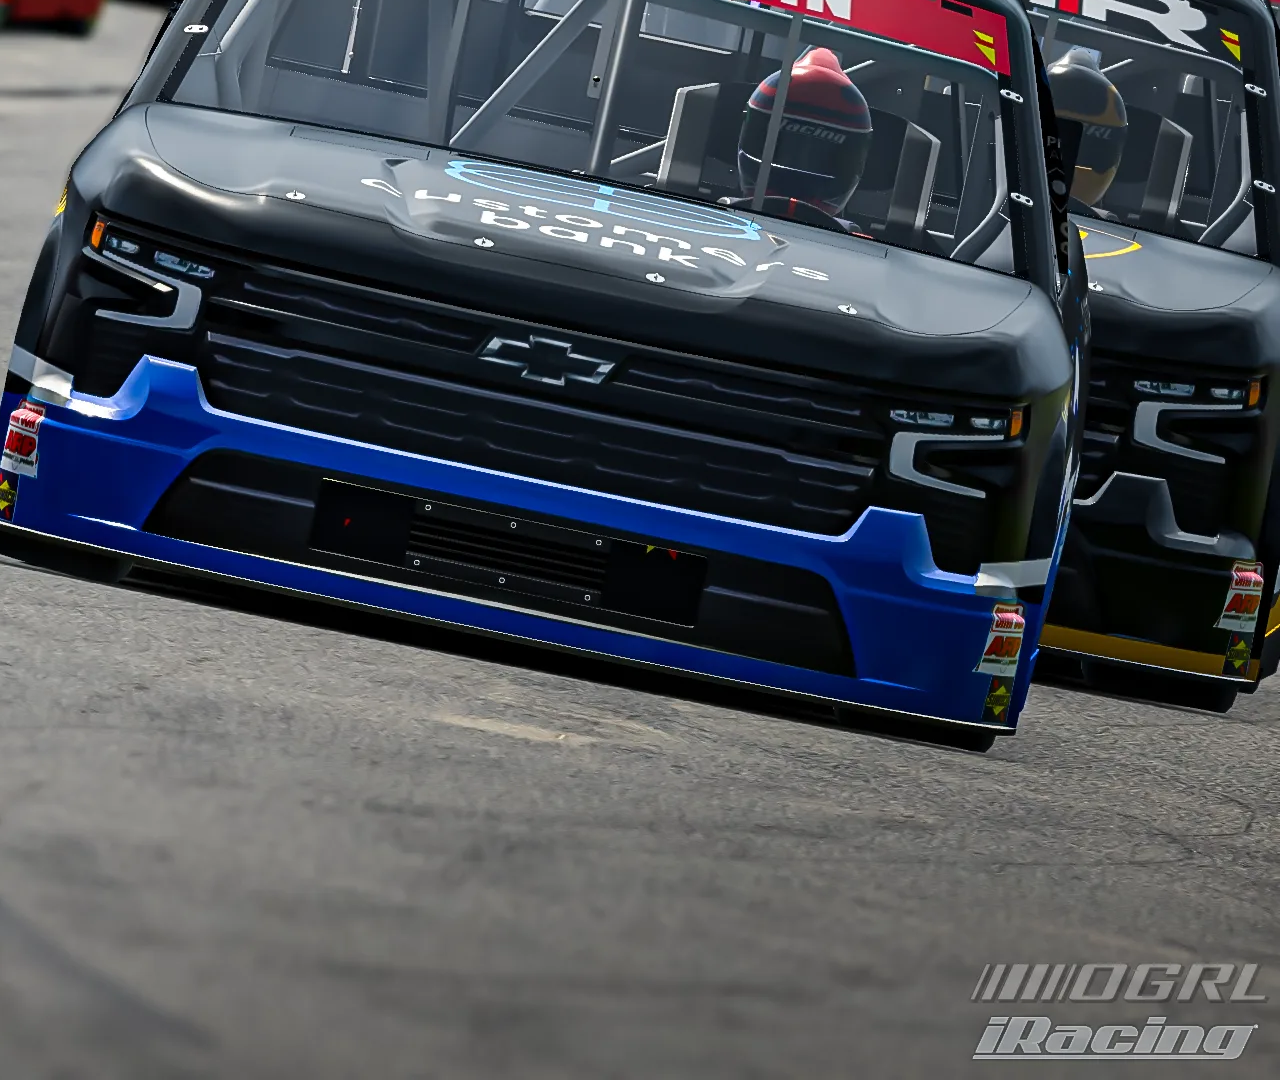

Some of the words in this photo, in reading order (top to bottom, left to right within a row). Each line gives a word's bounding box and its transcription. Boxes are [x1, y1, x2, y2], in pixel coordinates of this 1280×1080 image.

[361, 177, 830, 281] customers
[480, 210, 700, 269] bank
[5, 430, 37, 457] ARP
